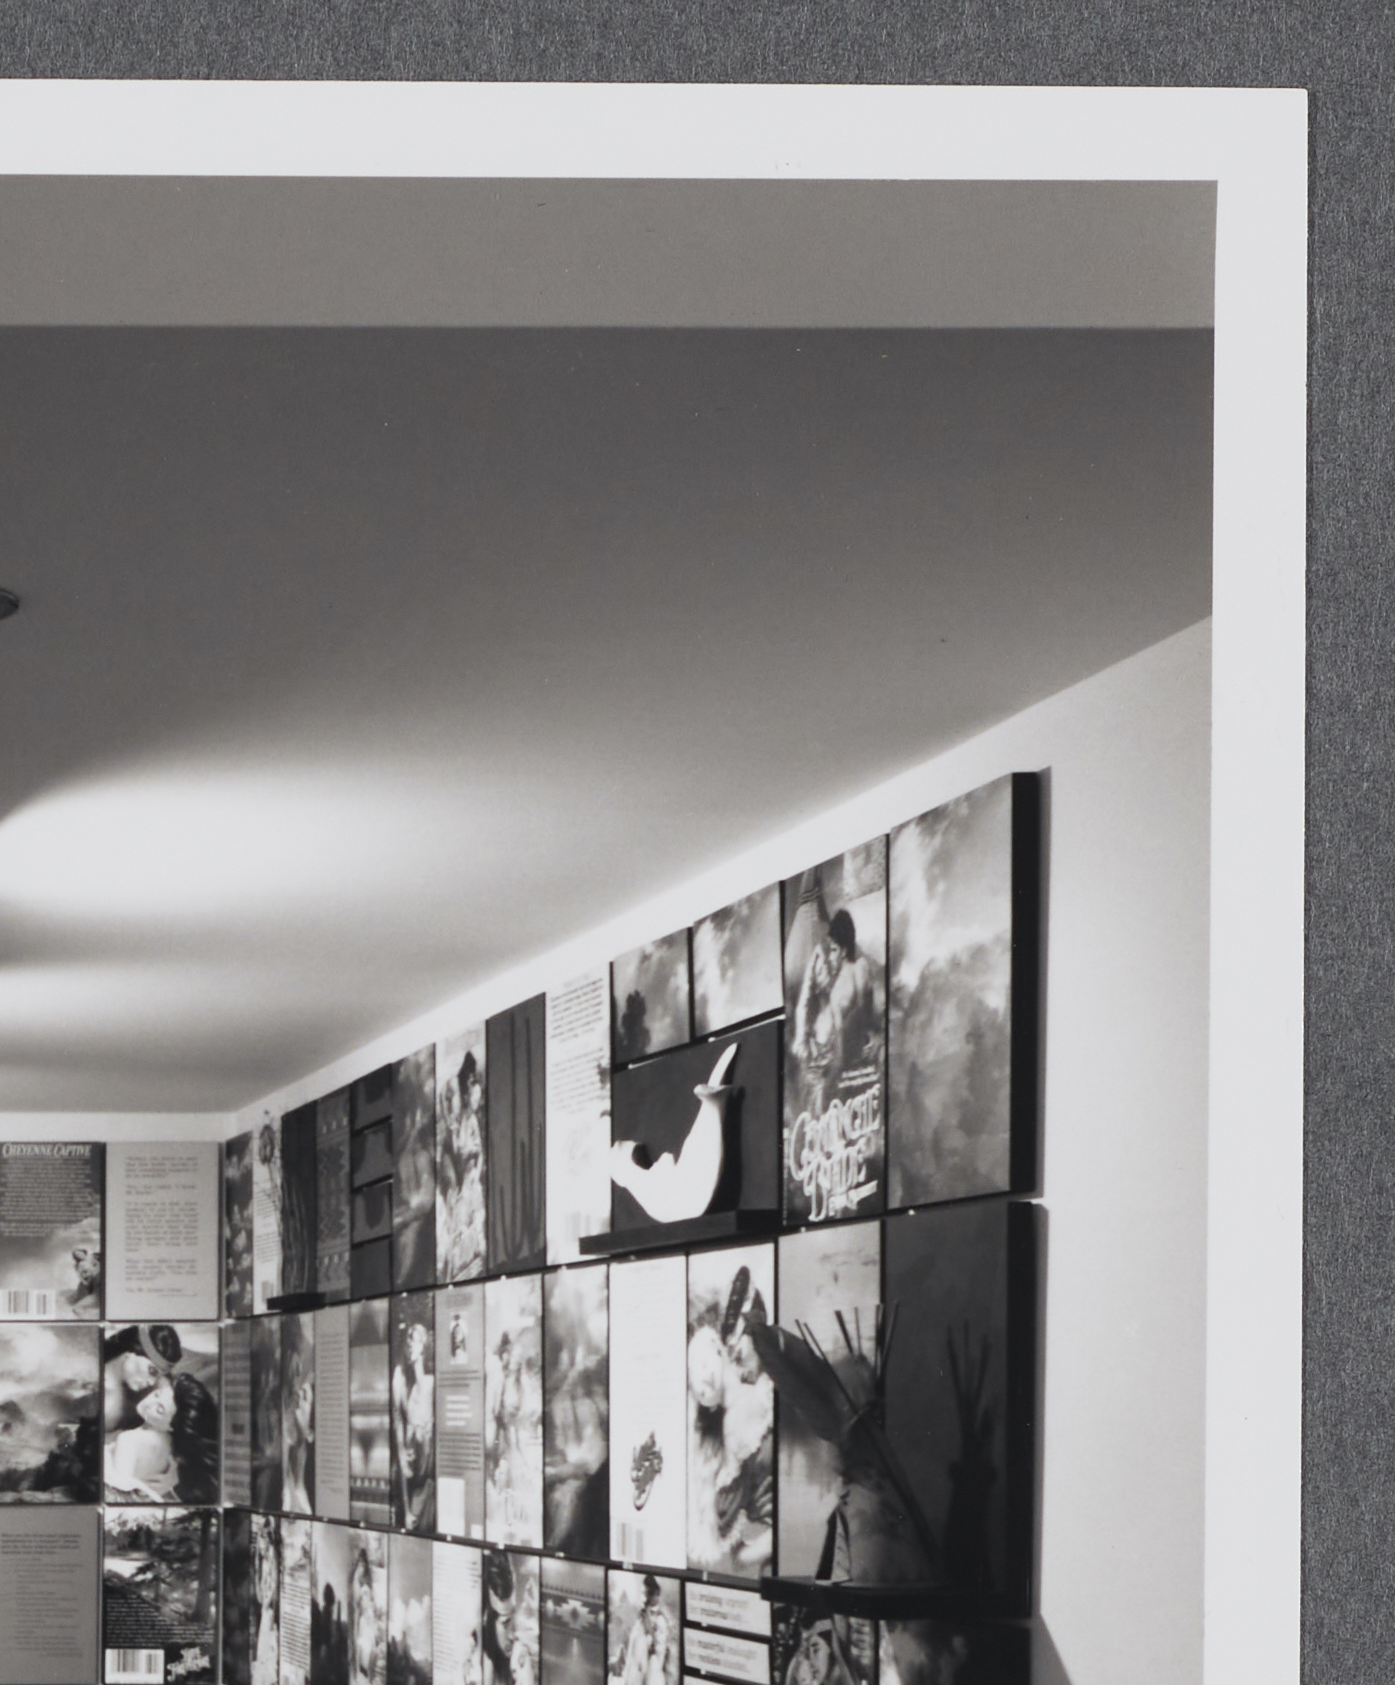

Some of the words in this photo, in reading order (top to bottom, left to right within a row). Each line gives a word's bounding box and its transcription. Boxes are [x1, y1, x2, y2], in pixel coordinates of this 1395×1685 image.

[2, 1144, 52, 1158] CHEYENNE
[53, 1144, 92, 1158] CAPTIVE
[790, 1083, 881, 1182] COMANCHE
